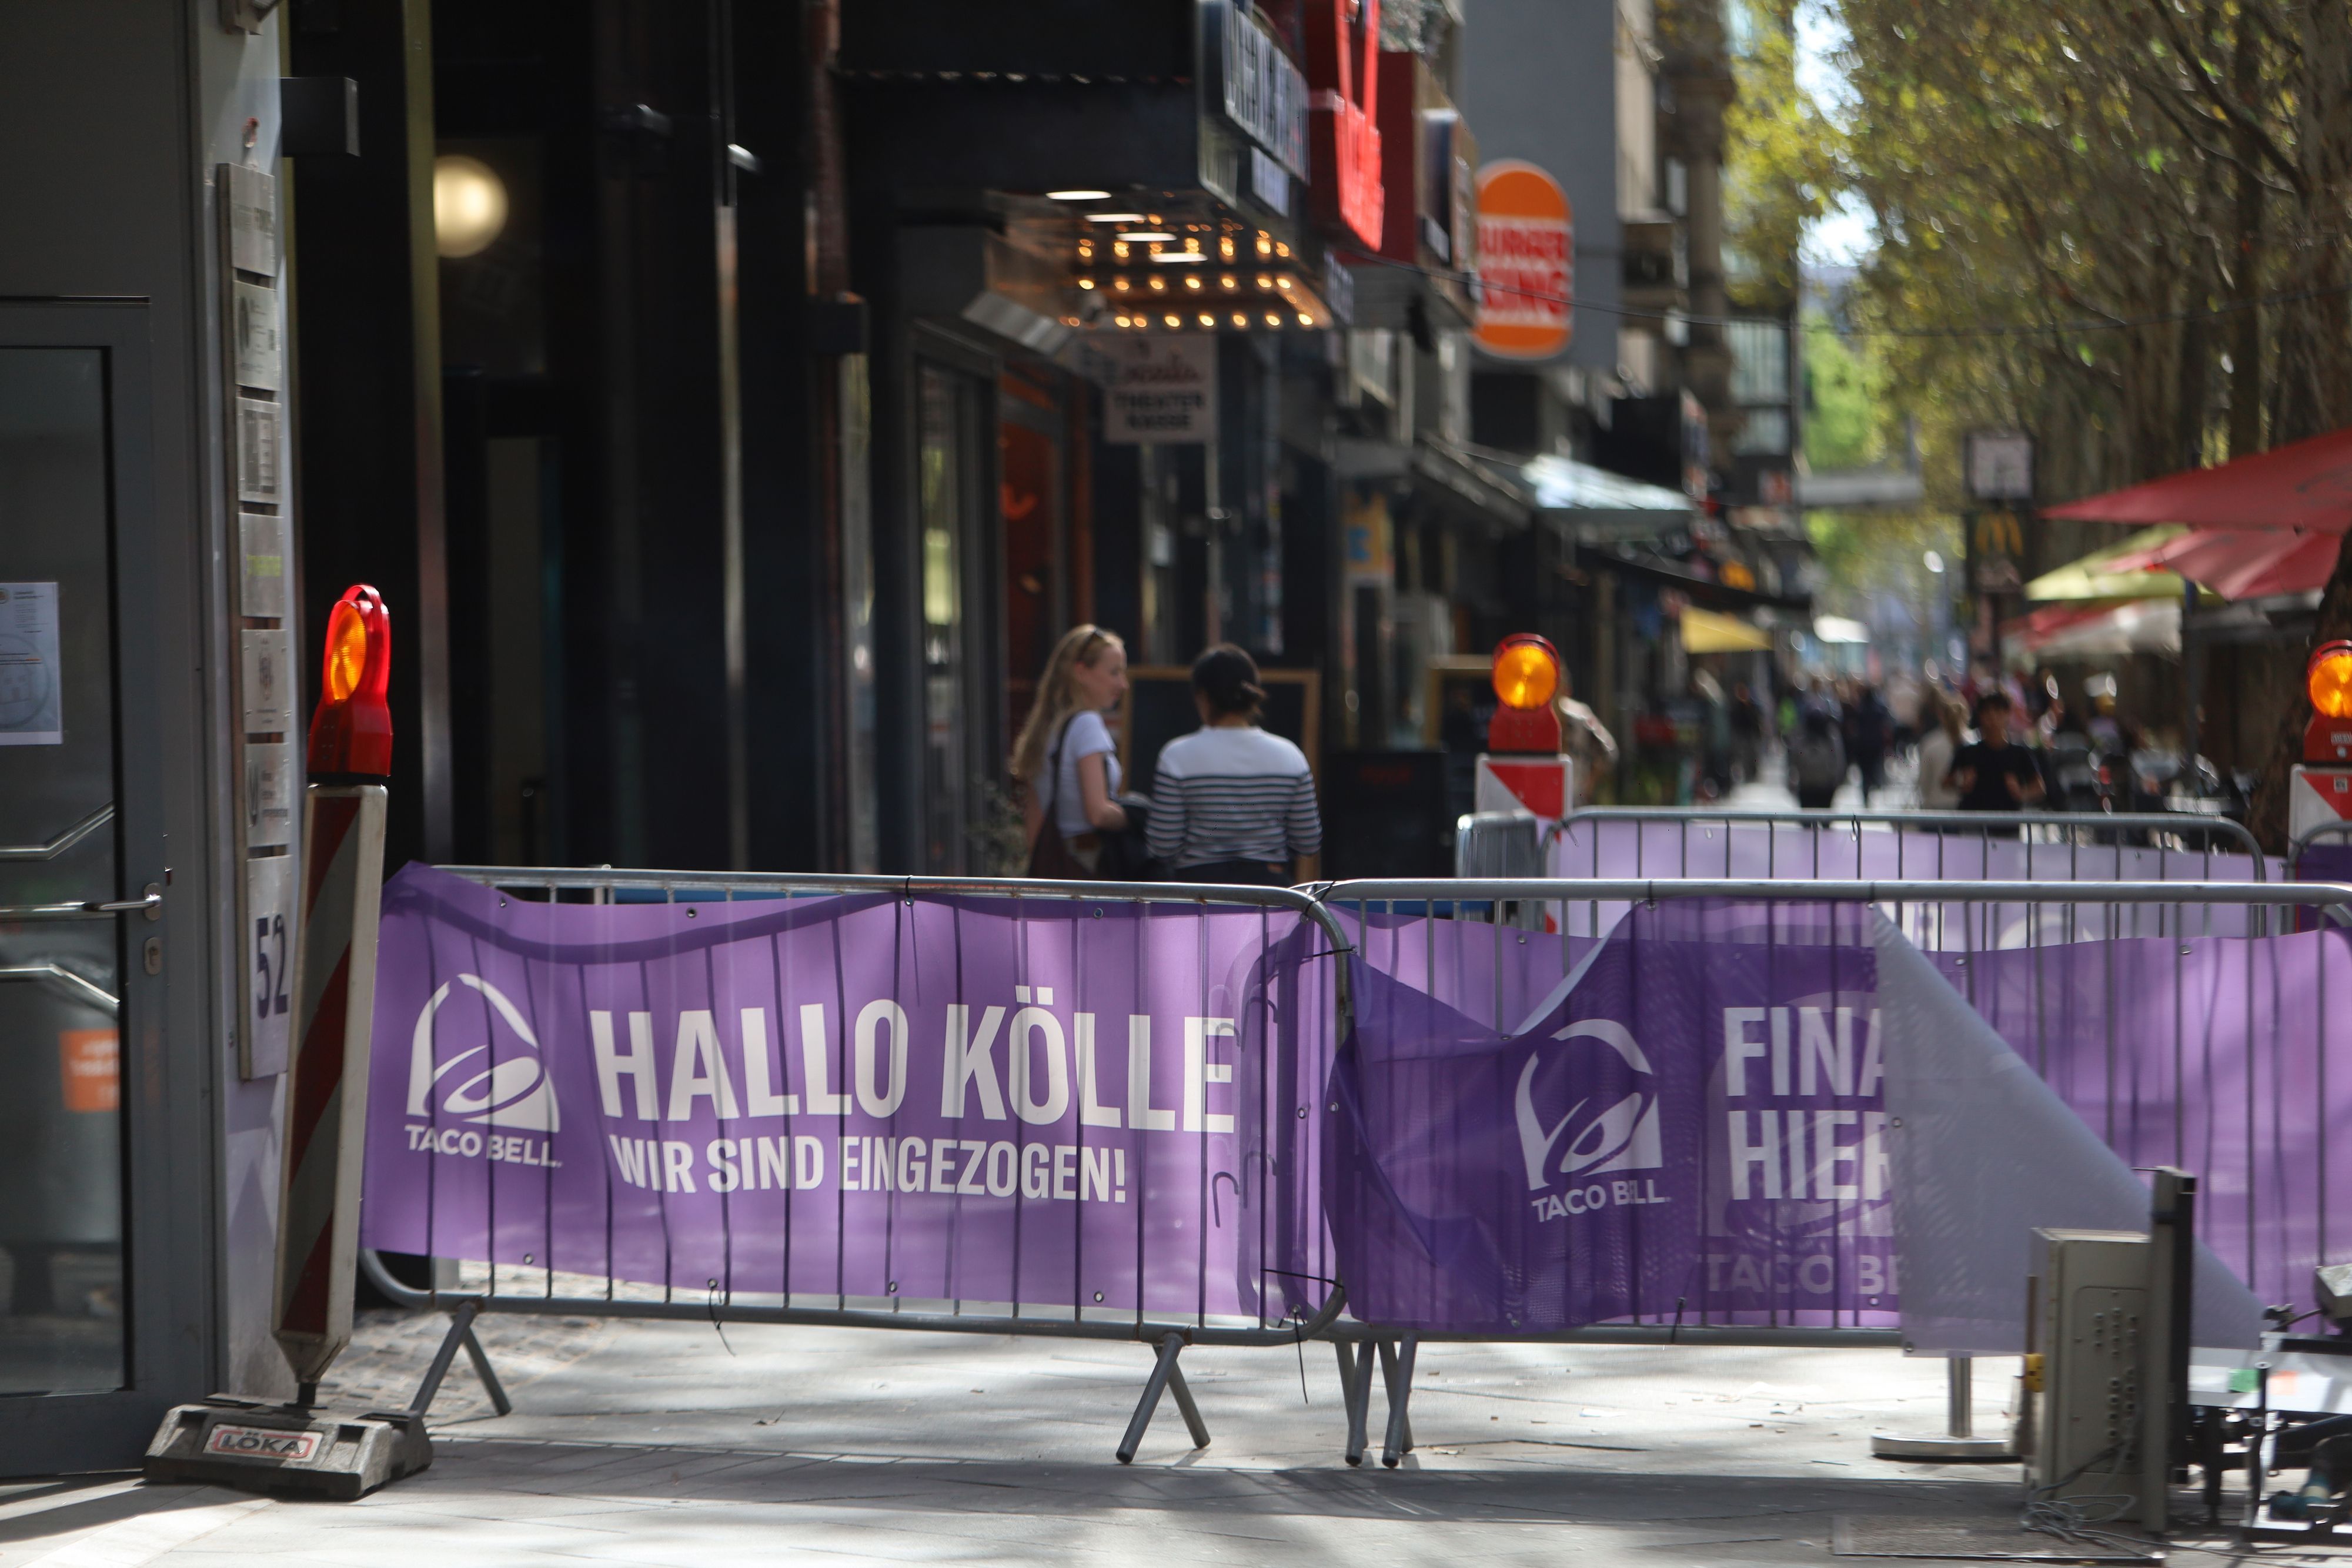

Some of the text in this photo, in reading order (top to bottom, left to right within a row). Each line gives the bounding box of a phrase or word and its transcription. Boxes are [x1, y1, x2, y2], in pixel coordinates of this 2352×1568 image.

[1474, 227, 1577, 262] URGER
[256, 913, 288, 1019] 52
[590, 985, 1234, 1134] HALLO KÖLLE
[405, 1124, 557, 1168] TACO BELL
[609, 1134, 1126, 1203] WIR SIND EINGEZOGEN!
[1531, 1185, 1606, 1223] TACO
[219, 1431, 303, 1455] LÖKA
